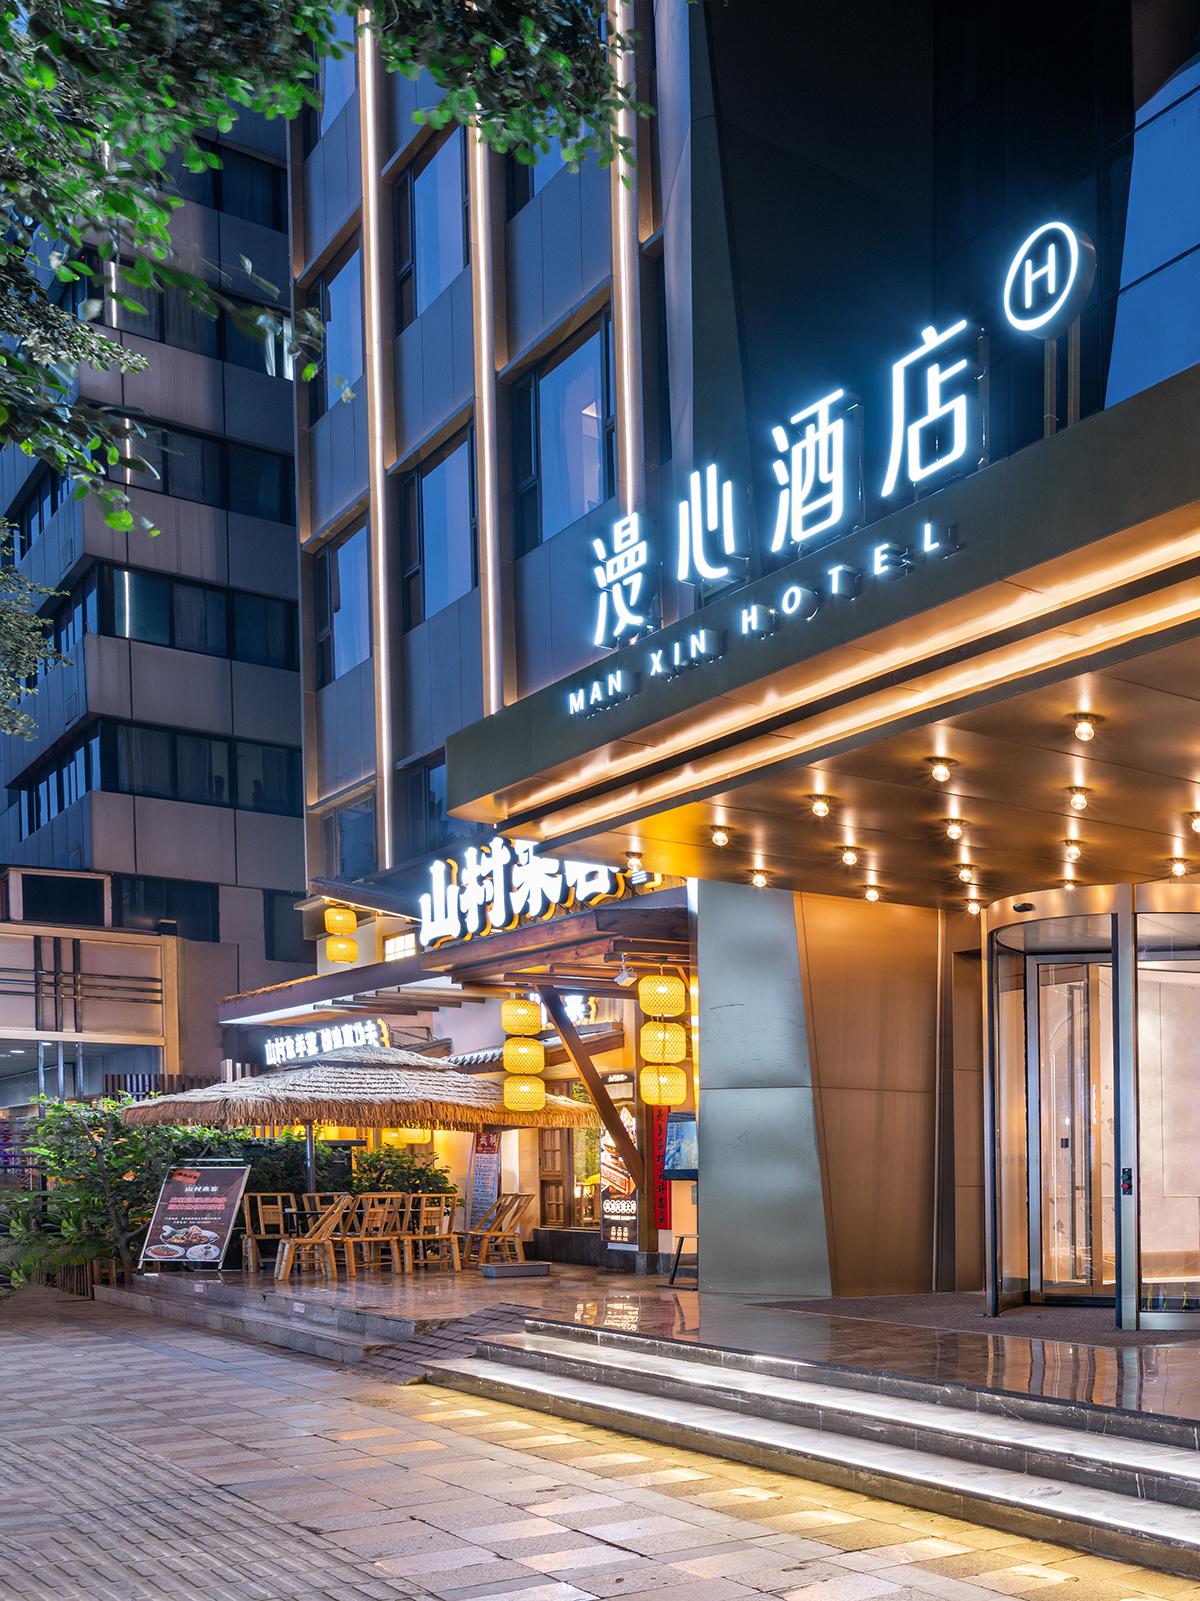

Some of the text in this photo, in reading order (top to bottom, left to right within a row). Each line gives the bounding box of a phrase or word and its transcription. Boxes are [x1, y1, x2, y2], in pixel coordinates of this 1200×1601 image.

[593, 320, 967, 647] 漫心酒店
[569, 523, 940, 715] MAN XIN HOTEL
